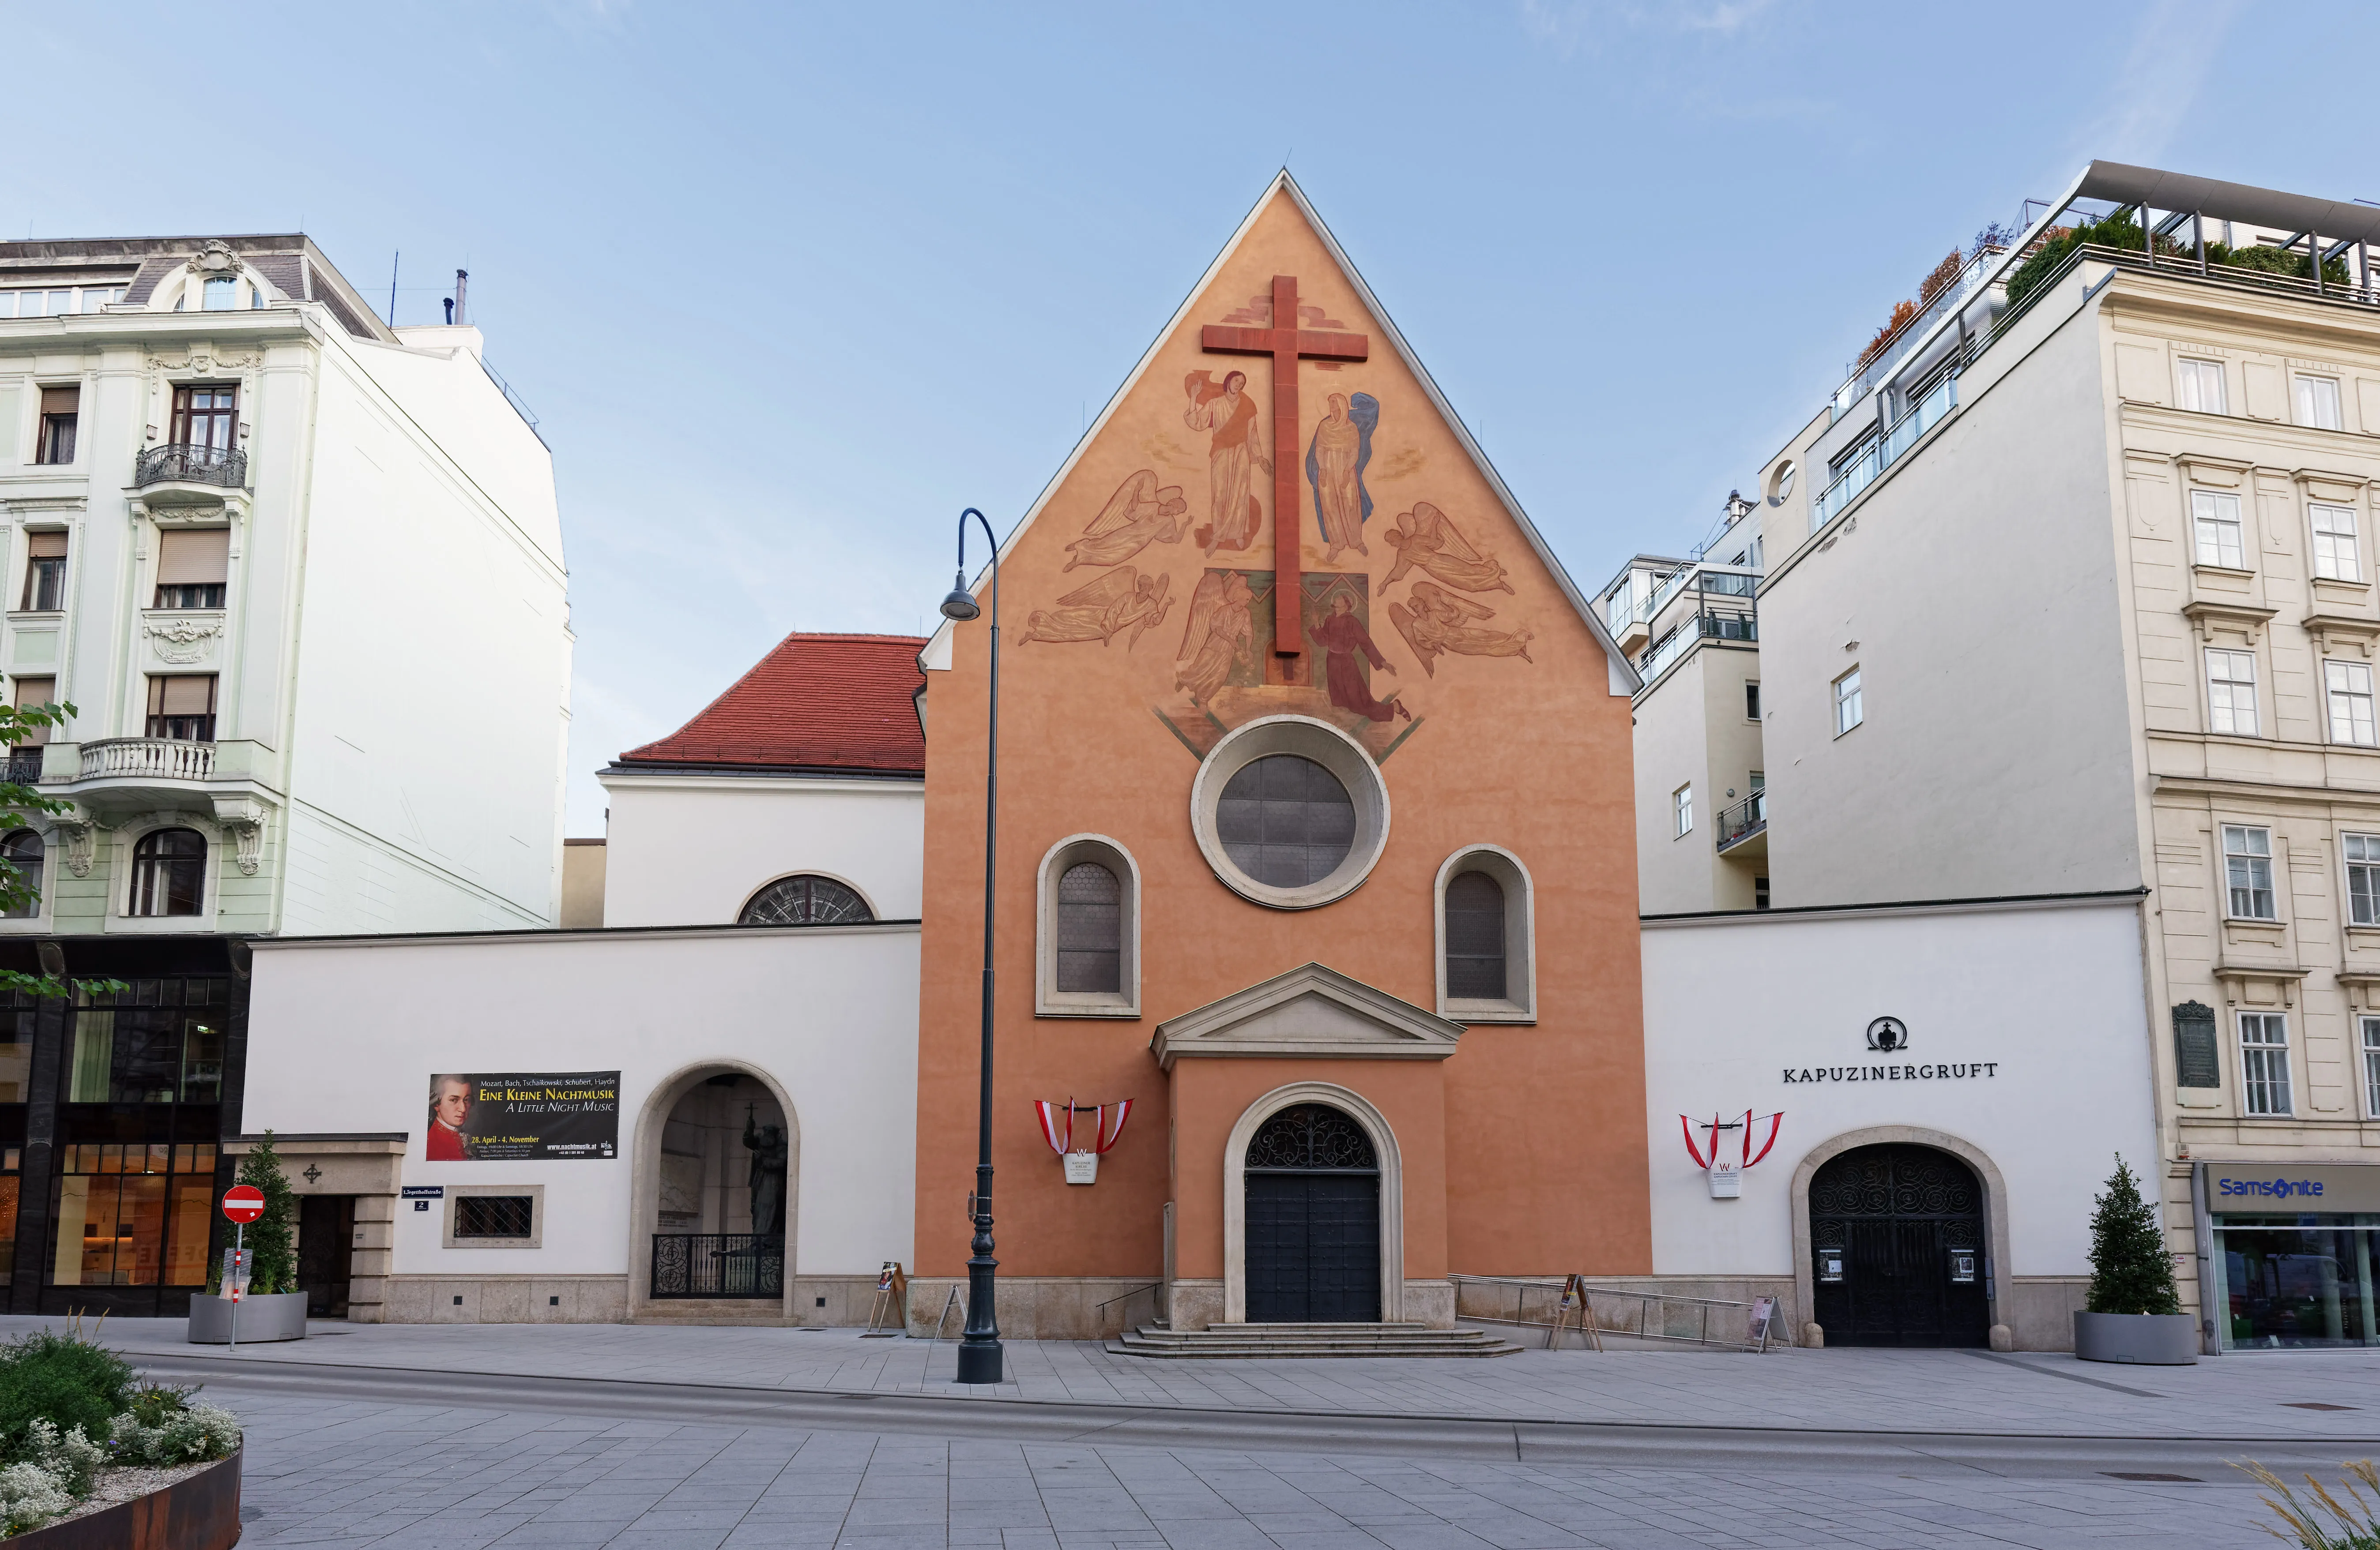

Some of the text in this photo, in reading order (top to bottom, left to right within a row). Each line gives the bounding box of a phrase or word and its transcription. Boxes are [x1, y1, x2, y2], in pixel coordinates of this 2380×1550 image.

[1783, 1063, 1998, 1083] KAPUZINERGRUFT
[479, 1088, 615, 1101] EINE KLEINE NACHTMUSIK
[505, 1101, 615, 1112] A LITTLE NIGHT MUSIC
[482, 1136, 497, 1145] April
[1077, 1148, 1087, 1157] W
[1719, 1163, 1730, 1171] W
[2219, 1178, 2324, 1198] Samsonite
